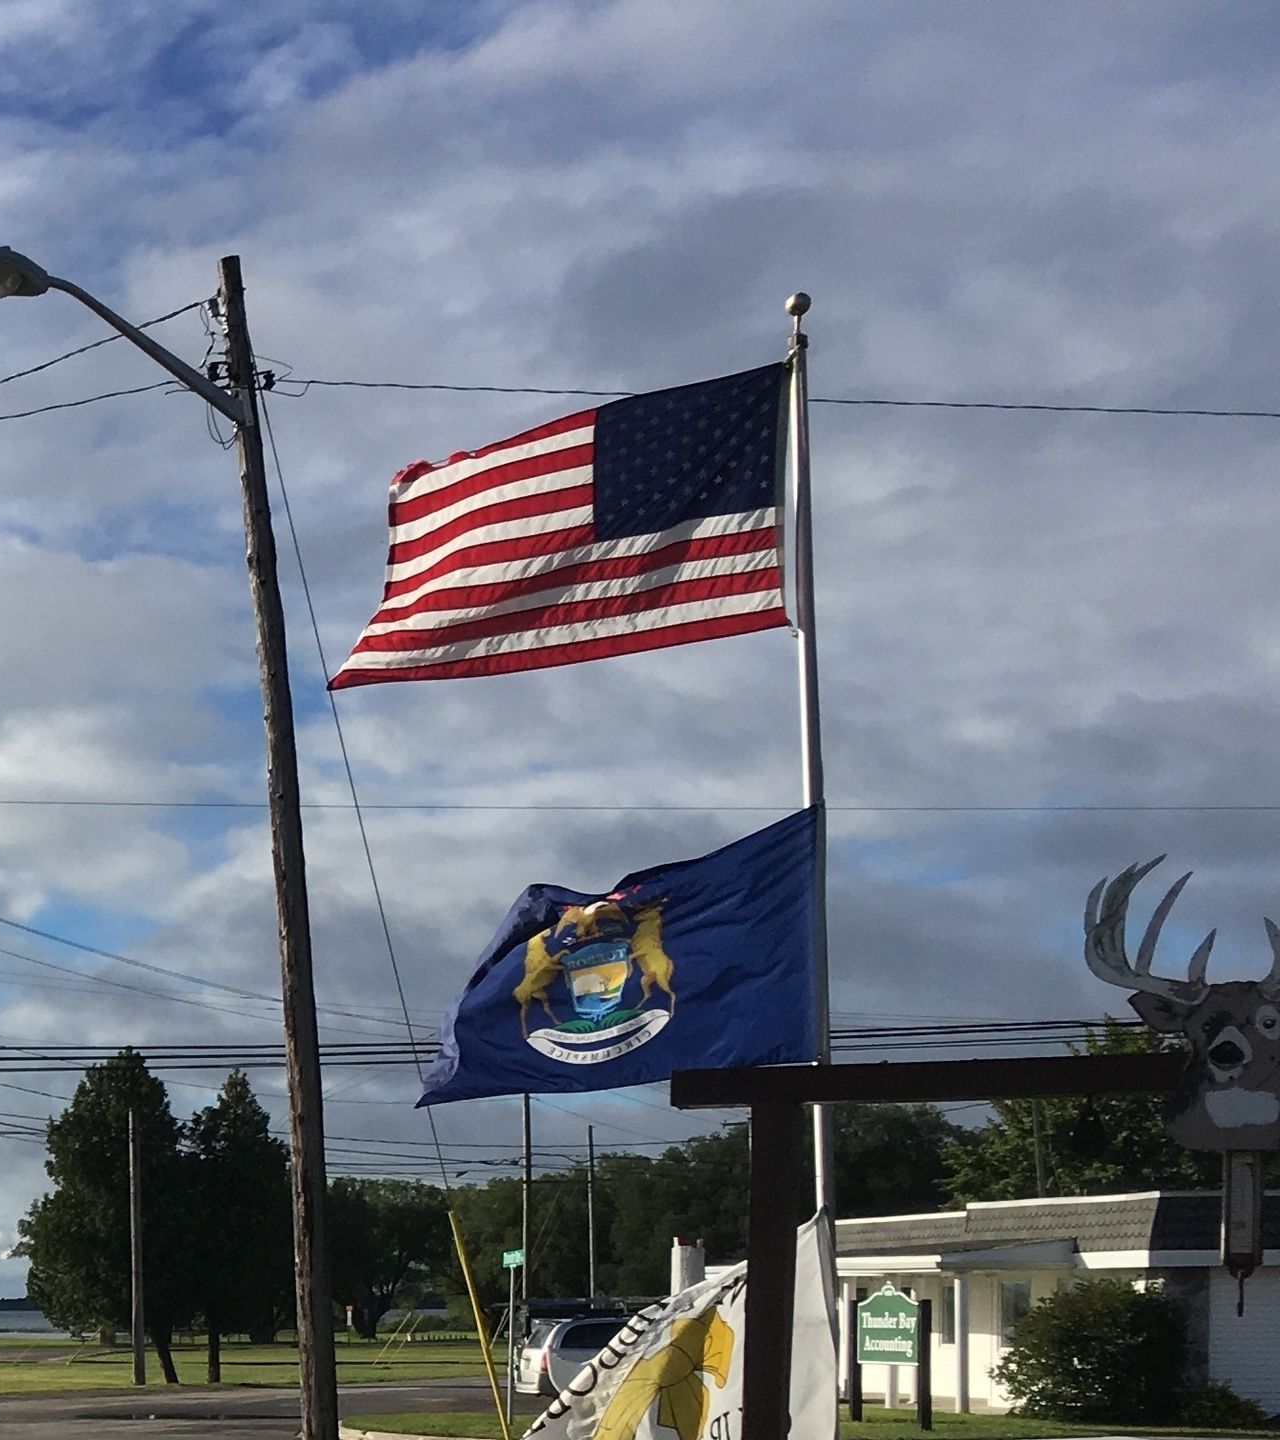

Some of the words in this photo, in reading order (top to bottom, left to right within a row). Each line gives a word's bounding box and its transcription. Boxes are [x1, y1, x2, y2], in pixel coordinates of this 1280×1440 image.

[862, 1312, 898, 1328] Thunder
[899, 1312, 917, 1333] Bay
[864, 1335, 913, 1357] Accounting
